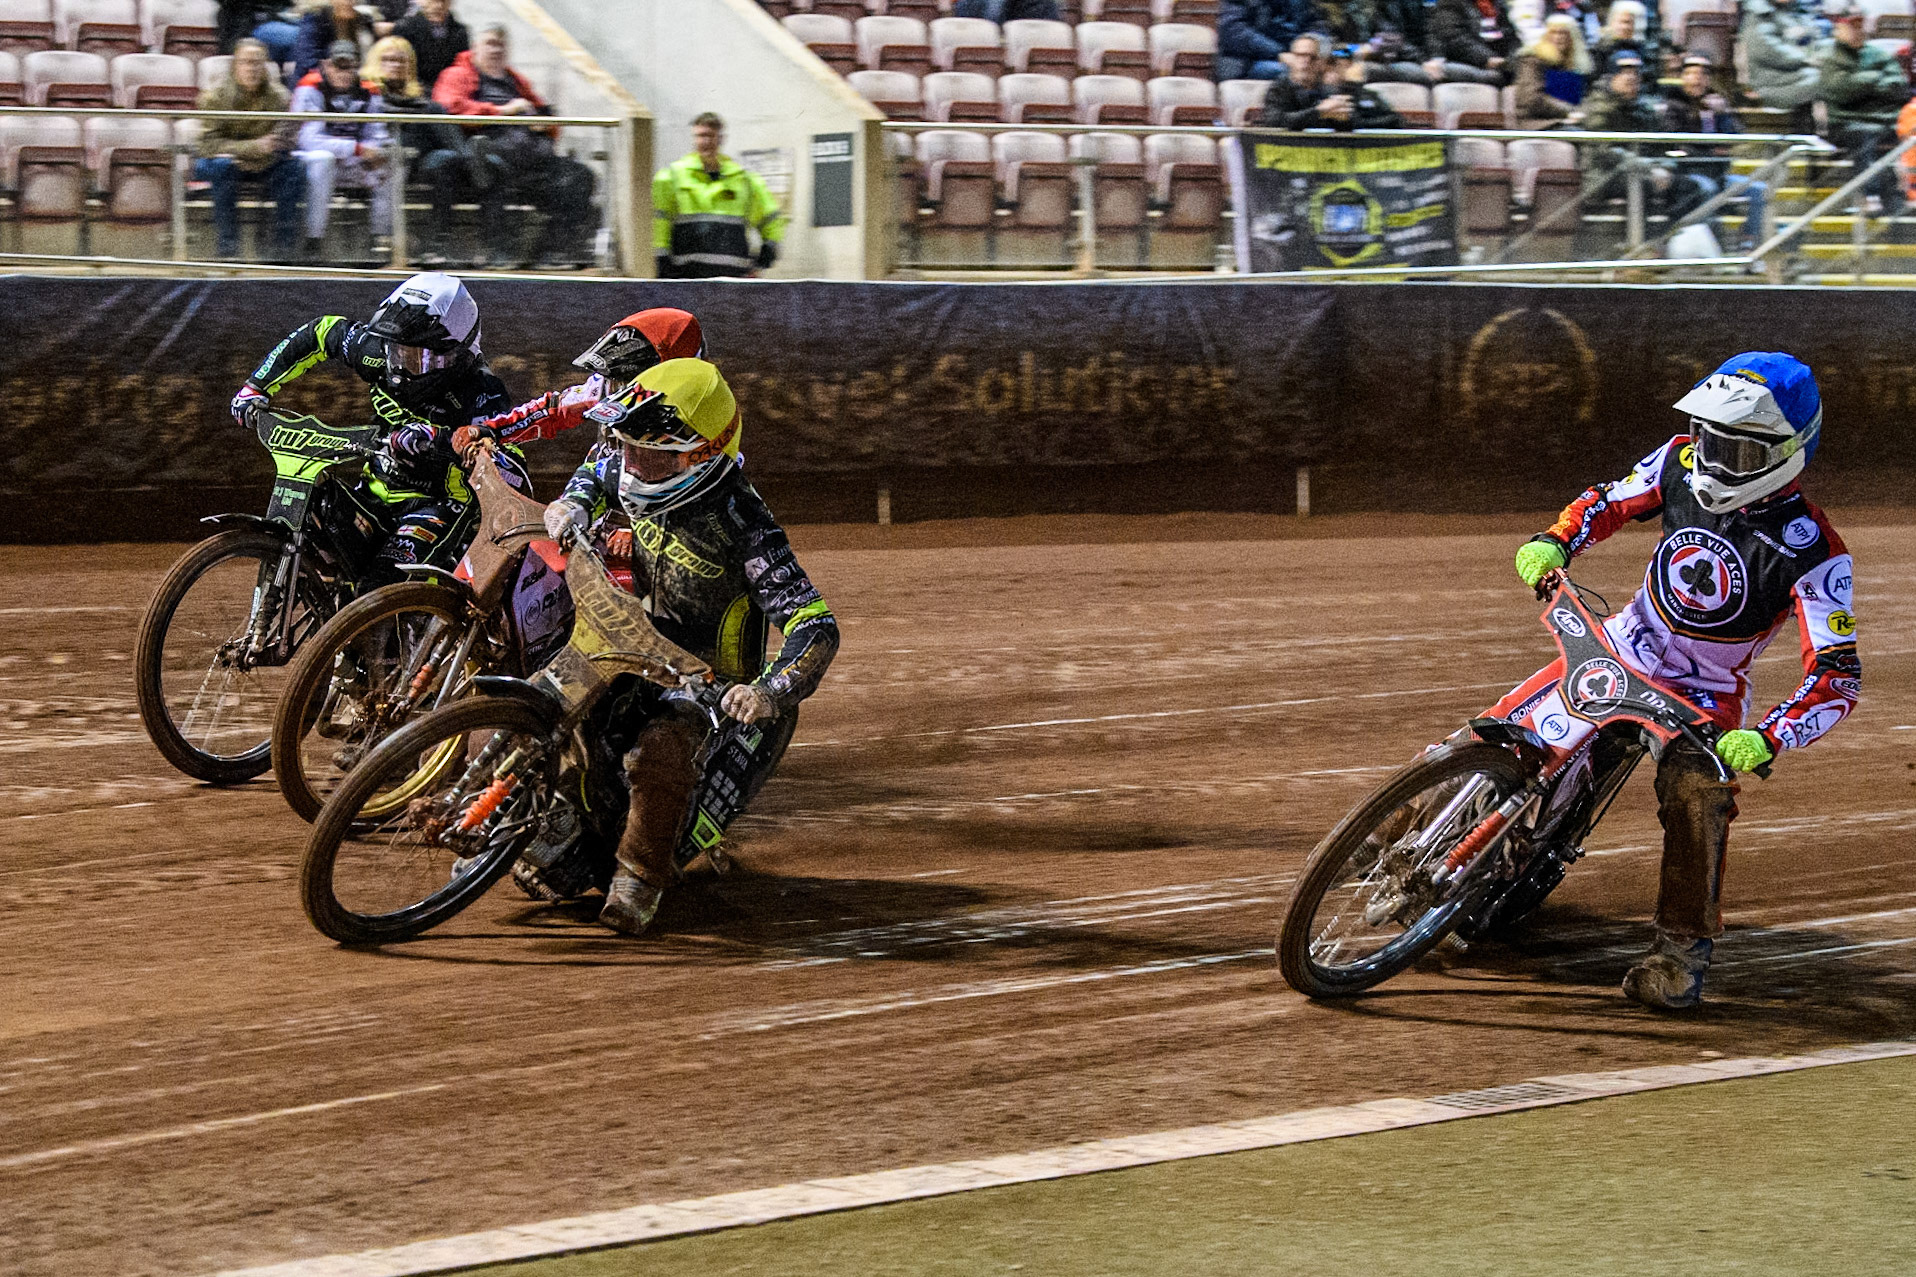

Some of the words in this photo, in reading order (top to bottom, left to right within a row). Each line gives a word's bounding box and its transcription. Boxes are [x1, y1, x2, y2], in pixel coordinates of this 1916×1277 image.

[268, 425, 317, 450] tru7
[1792, 522, 1810, 541] ATPI
[1669, 534, 1702, 550] BELLE
[1707, 538, 1730, 560] VUE
[1727, 562, 1743, 595] ACES
[1560, 612, 1583, 634] Arai
[1584, 661, 1609, 670] BELLE
[1609, 663, 1622, 677] VUE
[1615, 679, 1625, 697] ACES
